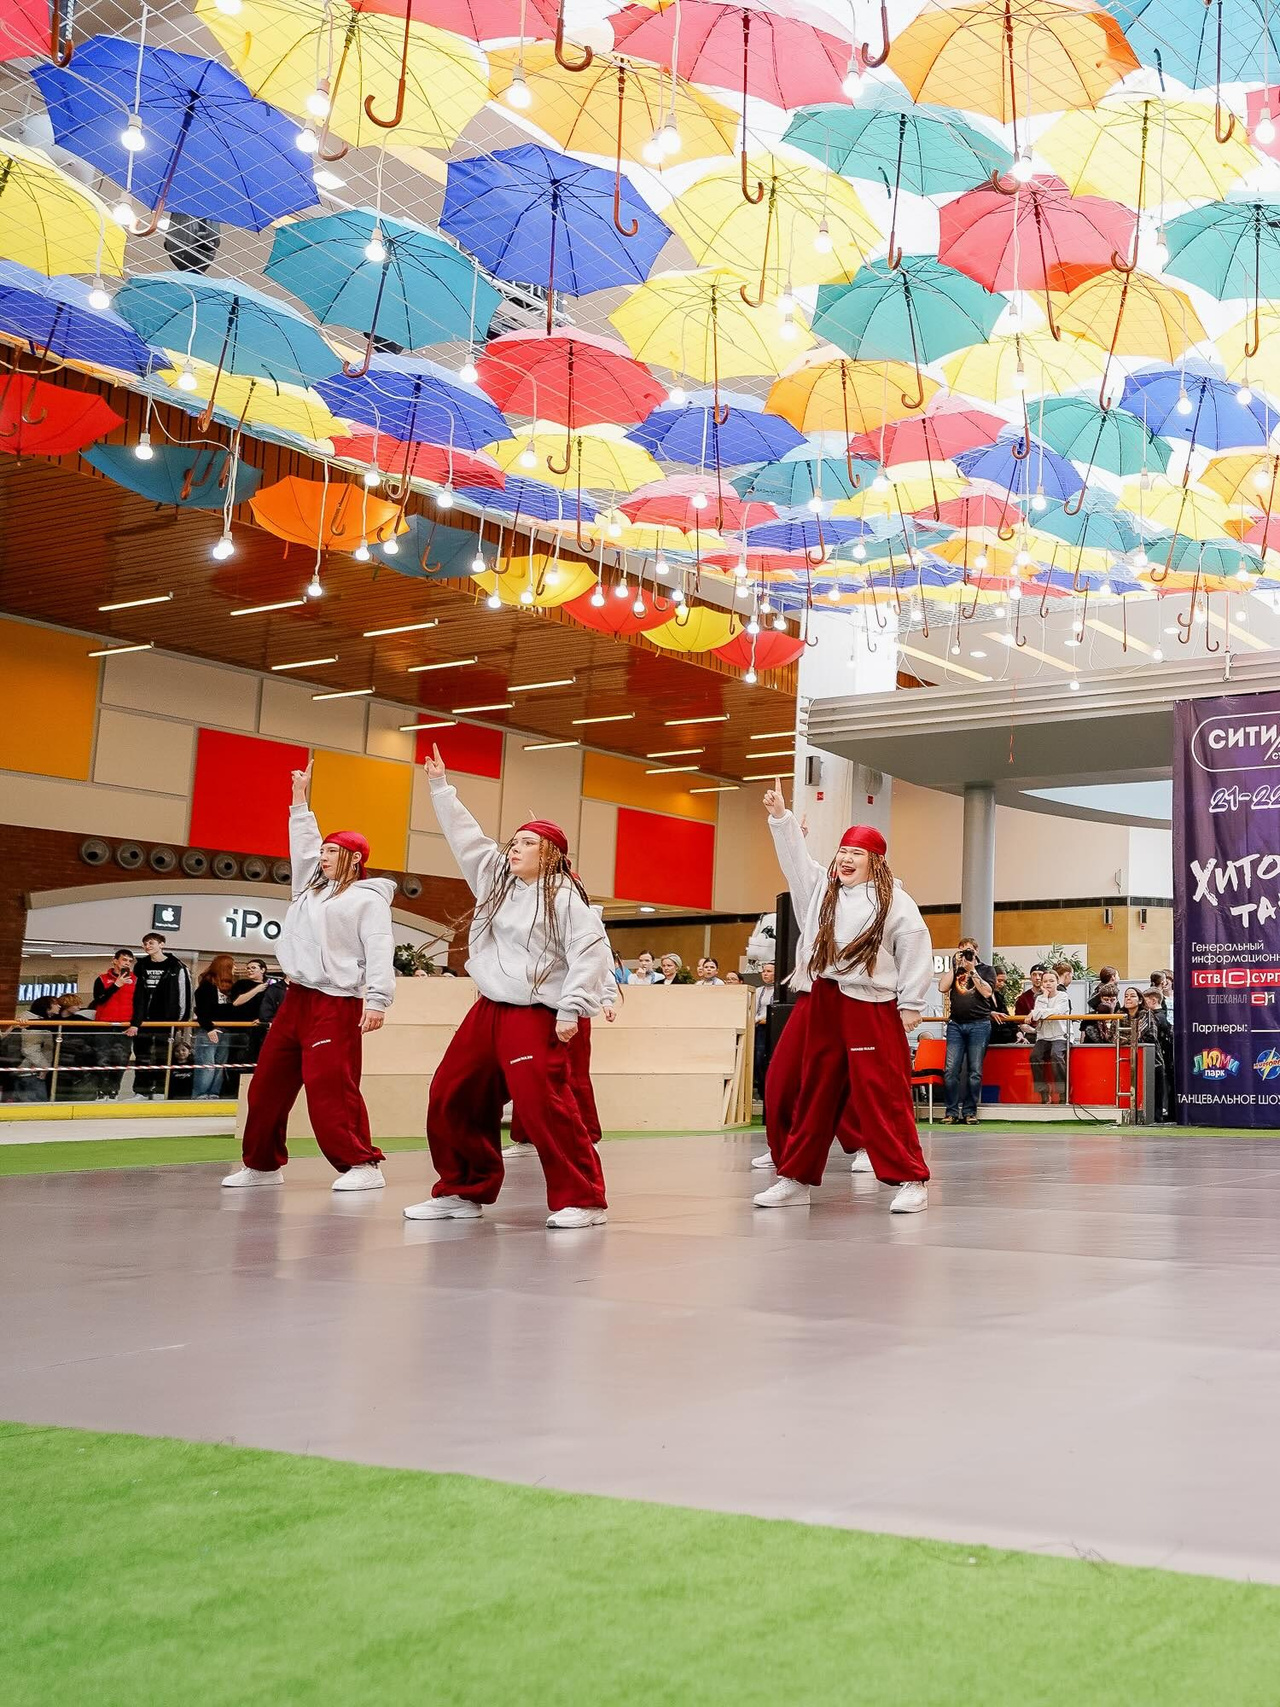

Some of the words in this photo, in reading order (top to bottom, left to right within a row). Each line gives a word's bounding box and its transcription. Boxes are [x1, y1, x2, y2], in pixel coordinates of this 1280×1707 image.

[1208, 724, 1278, 750] СИТИ
[225, 908, 282, 941] iPo
[1191, 940, 1265, 953] Генеральный
[1206, 993, 1248, 1004] ТЕЛЕКАНАЛ
[1192, 1022, 1249, 1035] Партнеры:
[1204, 1069, 1226, 1078] парк
[1177, 1093, 1256, 1105] ТАНЦЕВАЛЬНОЕ
